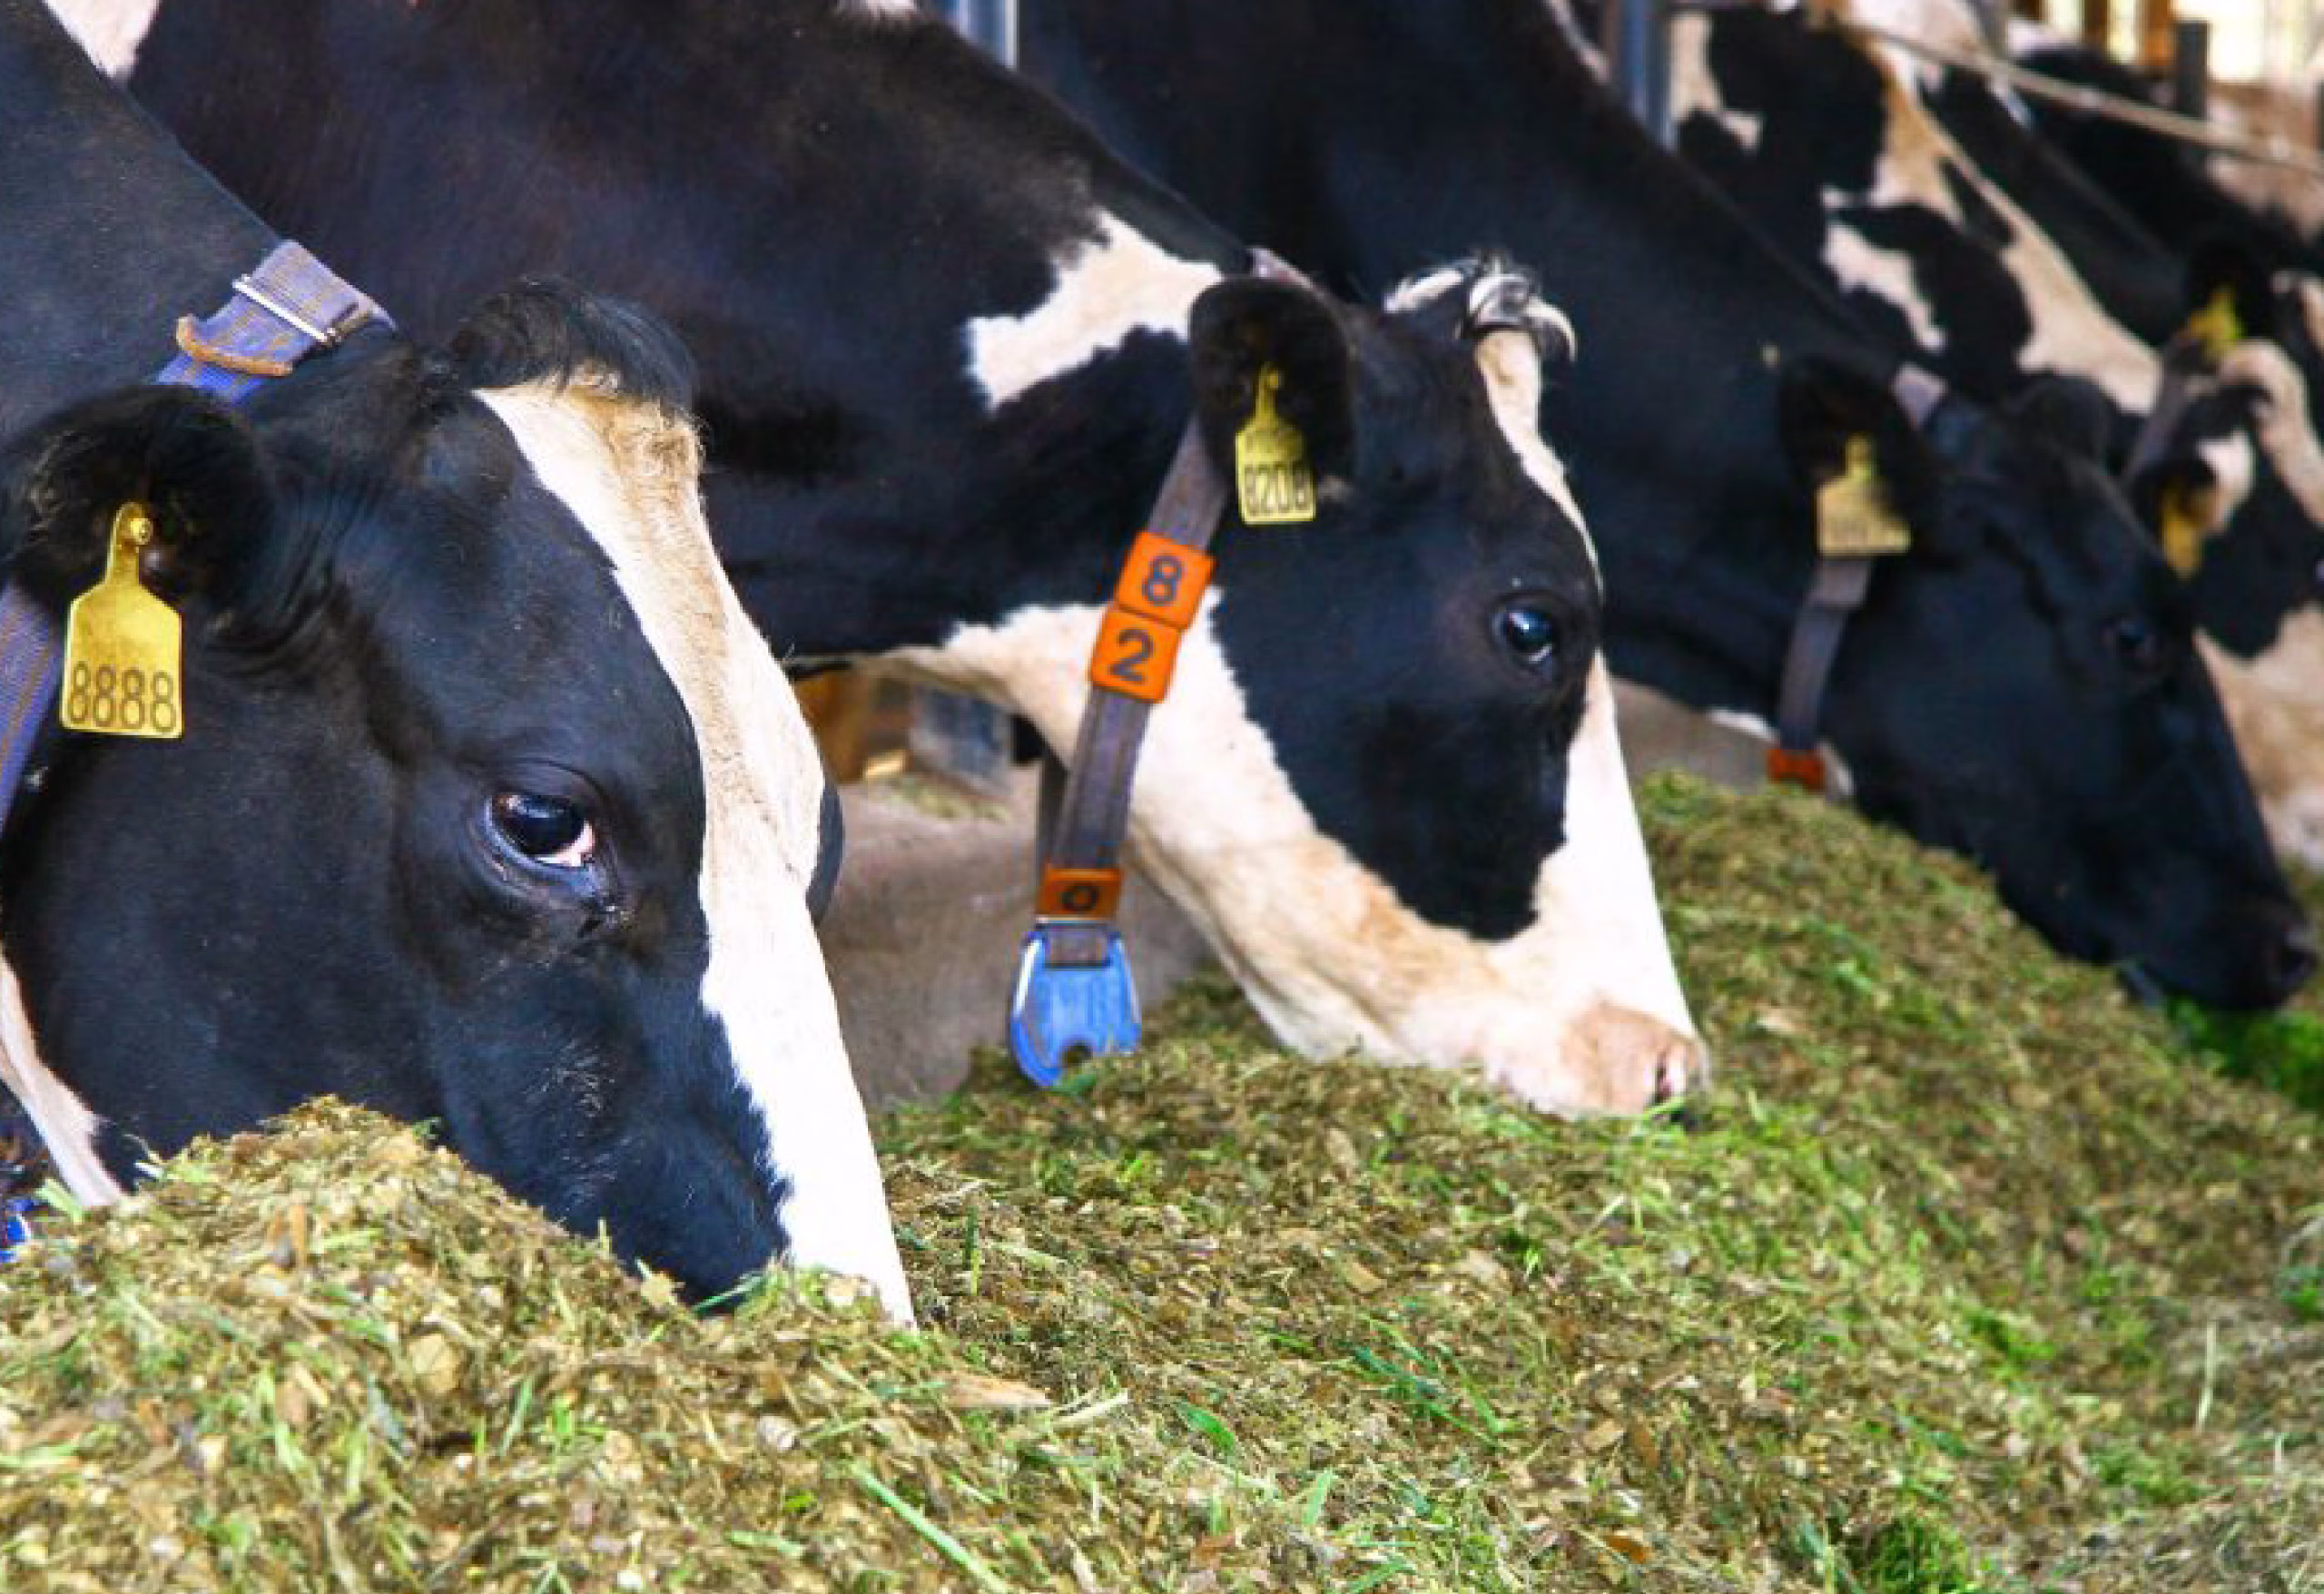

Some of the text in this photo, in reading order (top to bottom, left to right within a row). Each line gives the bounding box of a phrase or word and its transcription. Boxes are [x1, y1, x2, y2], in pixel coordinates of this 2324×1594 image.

[1143, 555, 1187, 607] 8
[1109, 628, 1154, 684] 2
[68, 661, 177, 733] 8888
